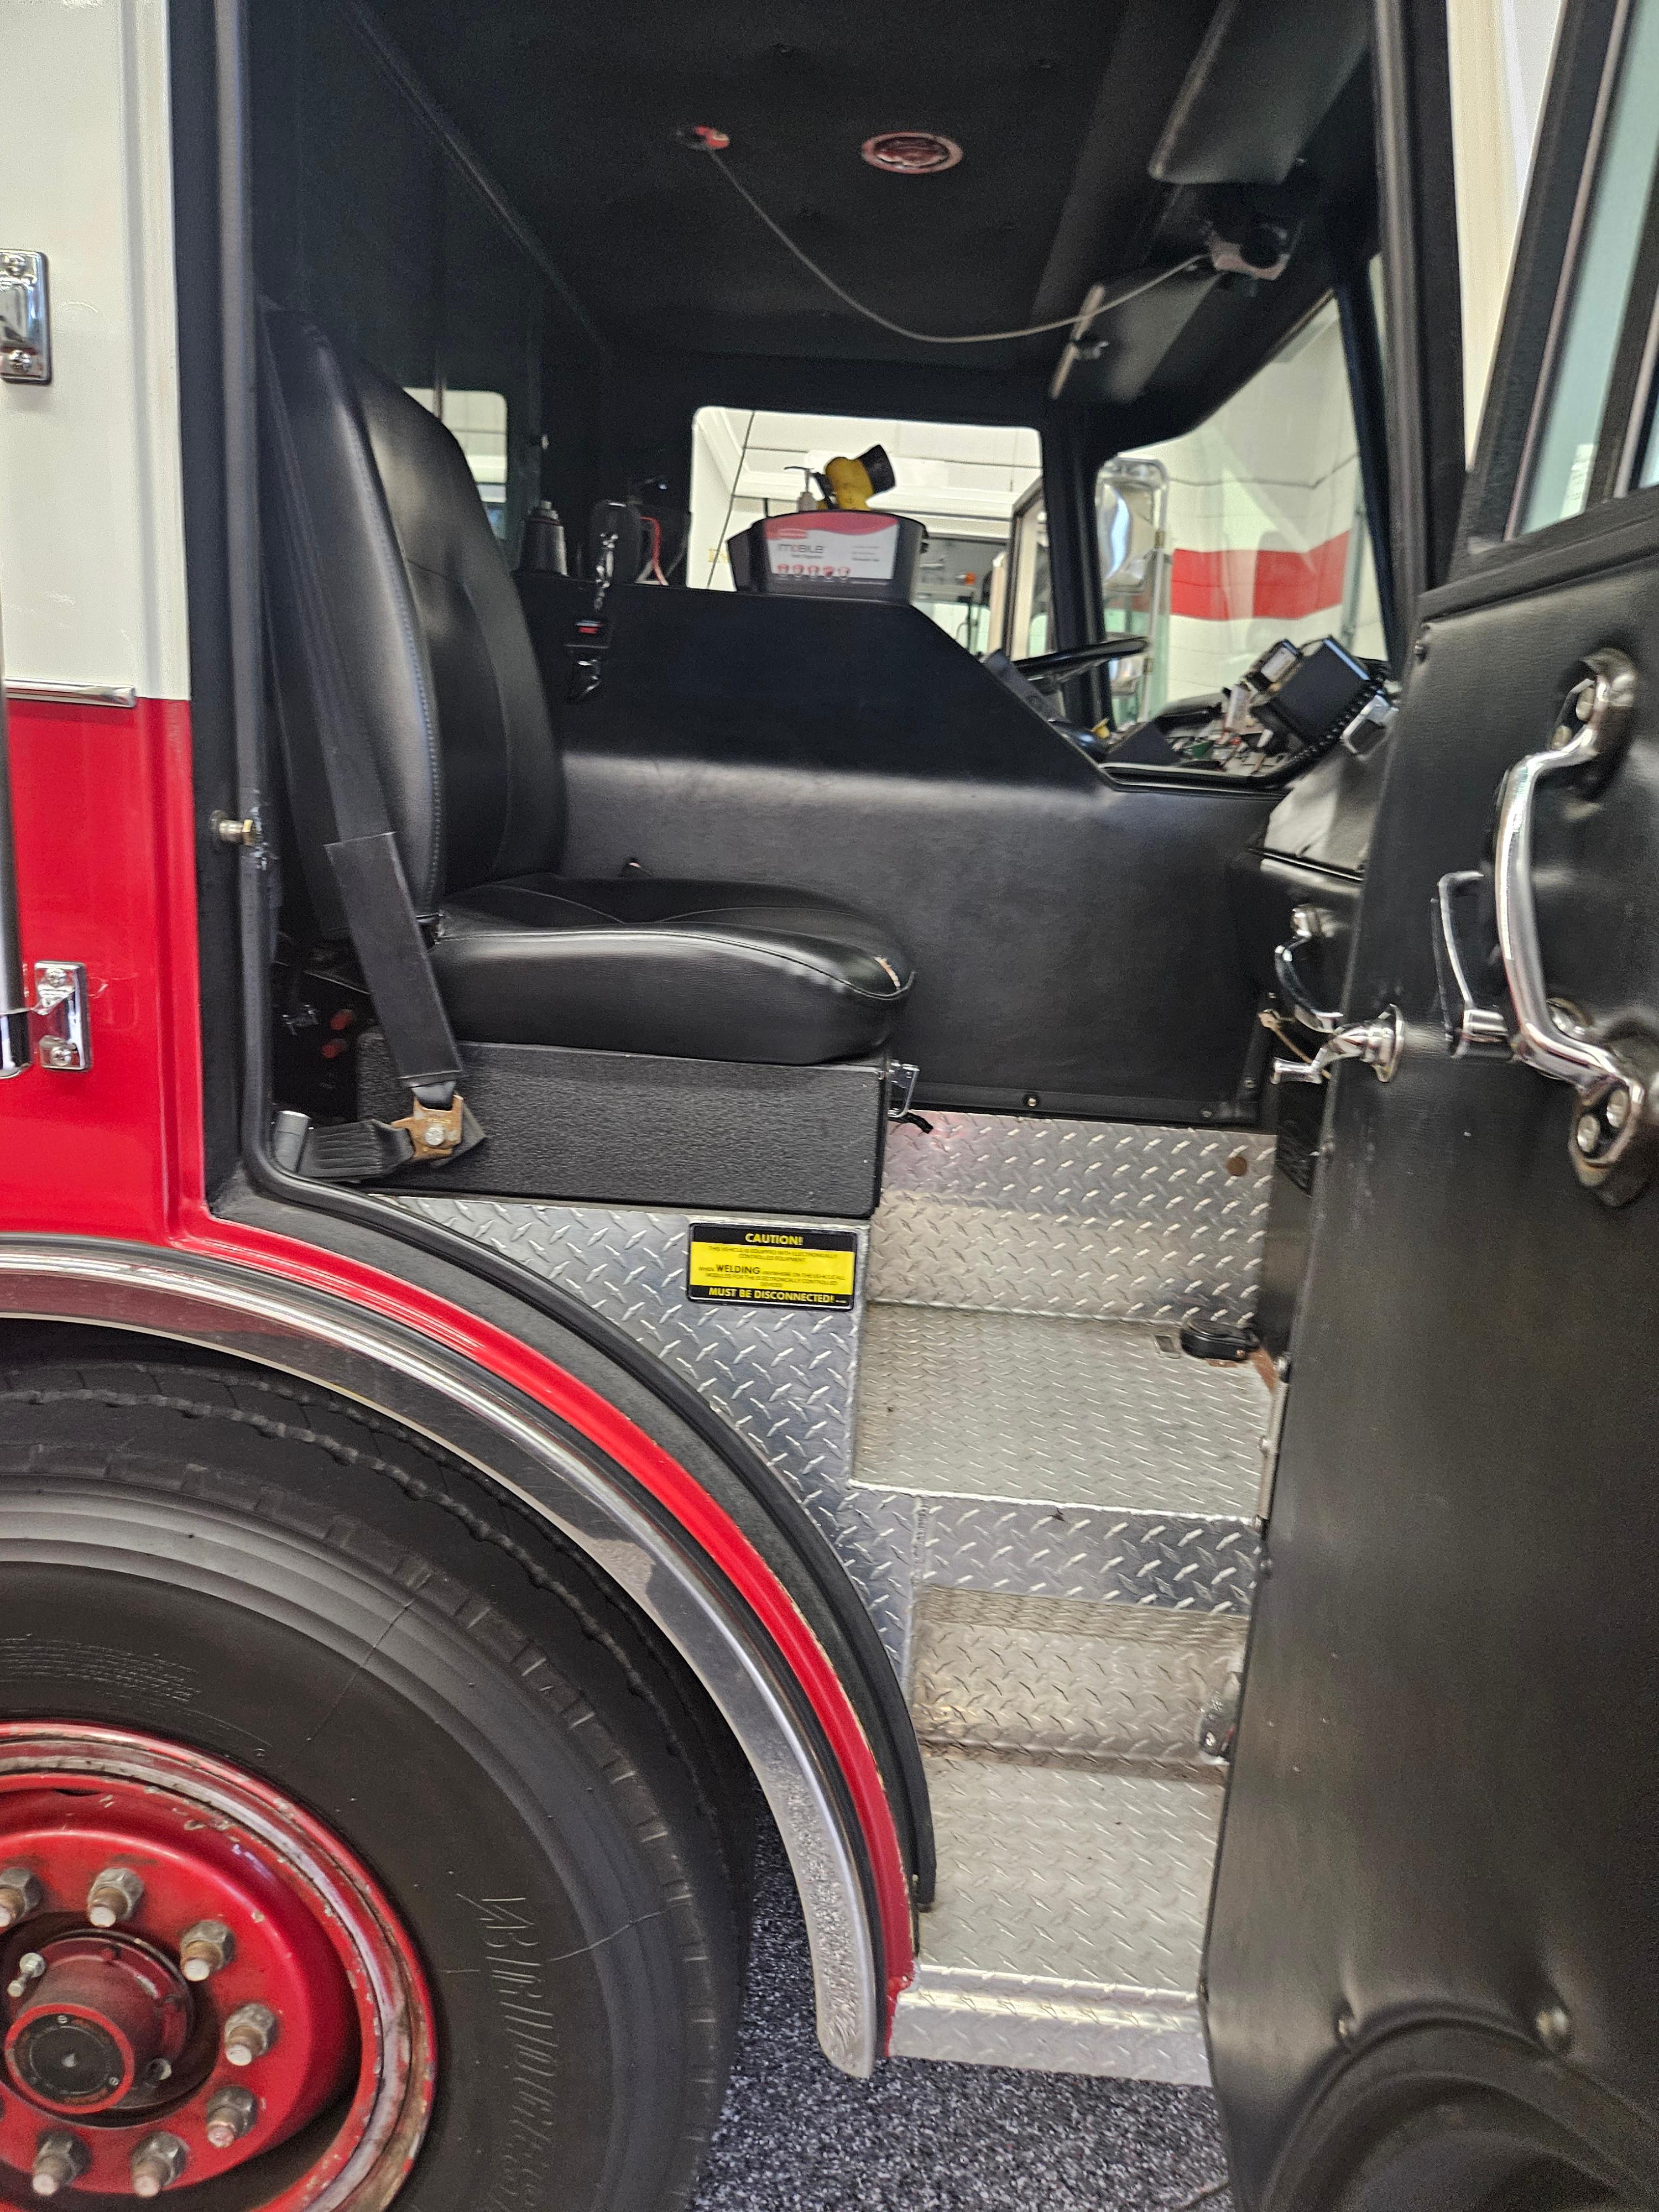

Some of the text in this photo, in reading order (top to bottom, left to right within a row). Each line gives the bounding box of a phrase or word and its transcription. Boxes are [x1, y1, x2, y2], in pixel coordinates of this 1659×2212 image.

[745, 1233, 804, 1245] CAUTION!
[716, 1264, 760, 1274] WELDING
[708, 1287, 737, 1297] MUST
[739, 1288, 753, 1298] BE
[754, 1290, 835, 1303] DISCONNECTED!
